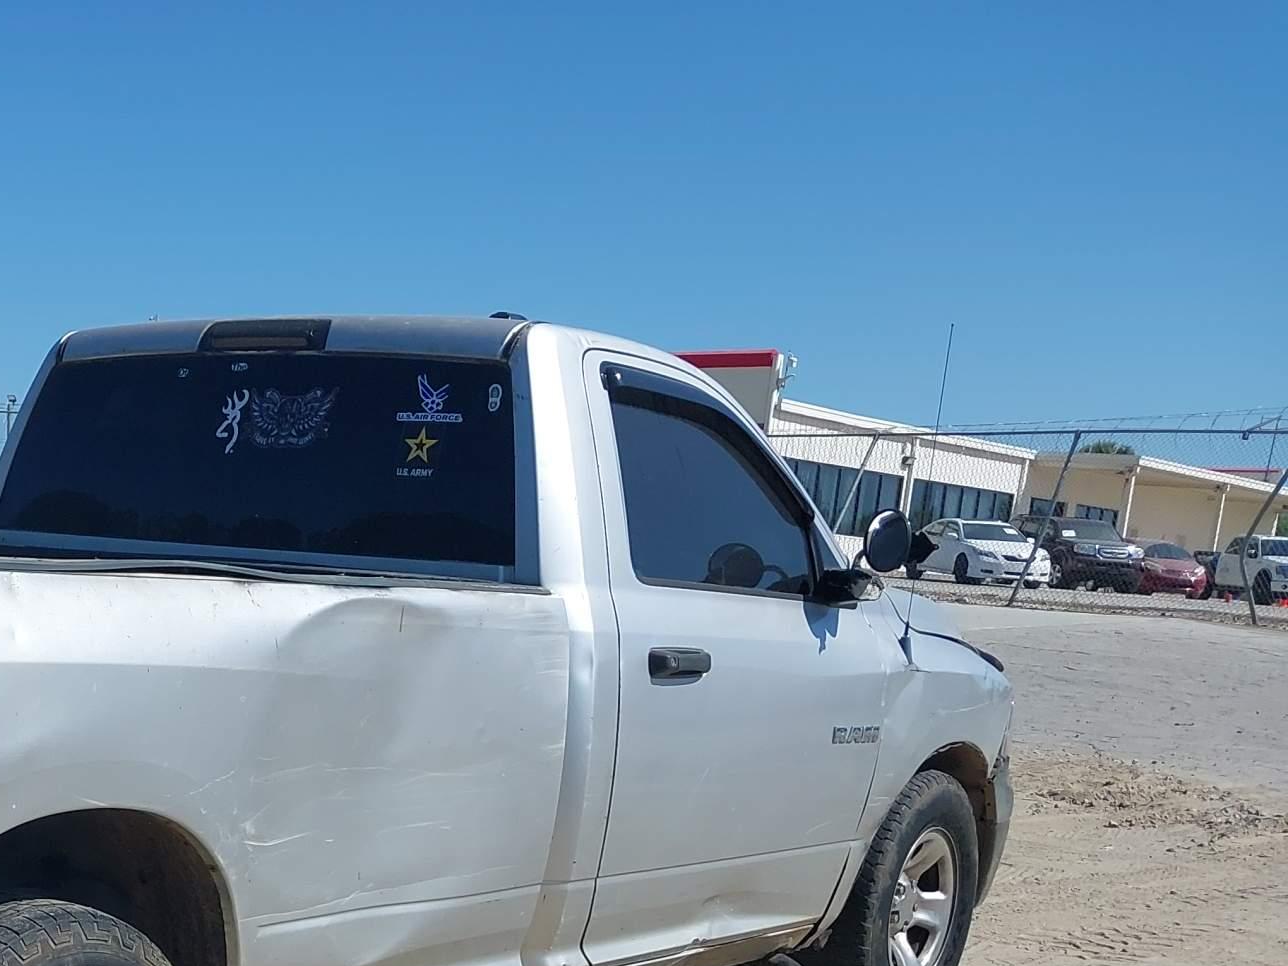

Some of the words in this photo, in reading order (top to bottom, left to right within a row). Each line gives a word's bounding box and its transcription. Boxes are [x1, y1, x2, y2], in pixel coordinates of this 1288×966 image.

[414, 413, 430, 421] AIR
[430, 414, 462, 422] FORCE
[410, 468, 433, 477] ARMY
